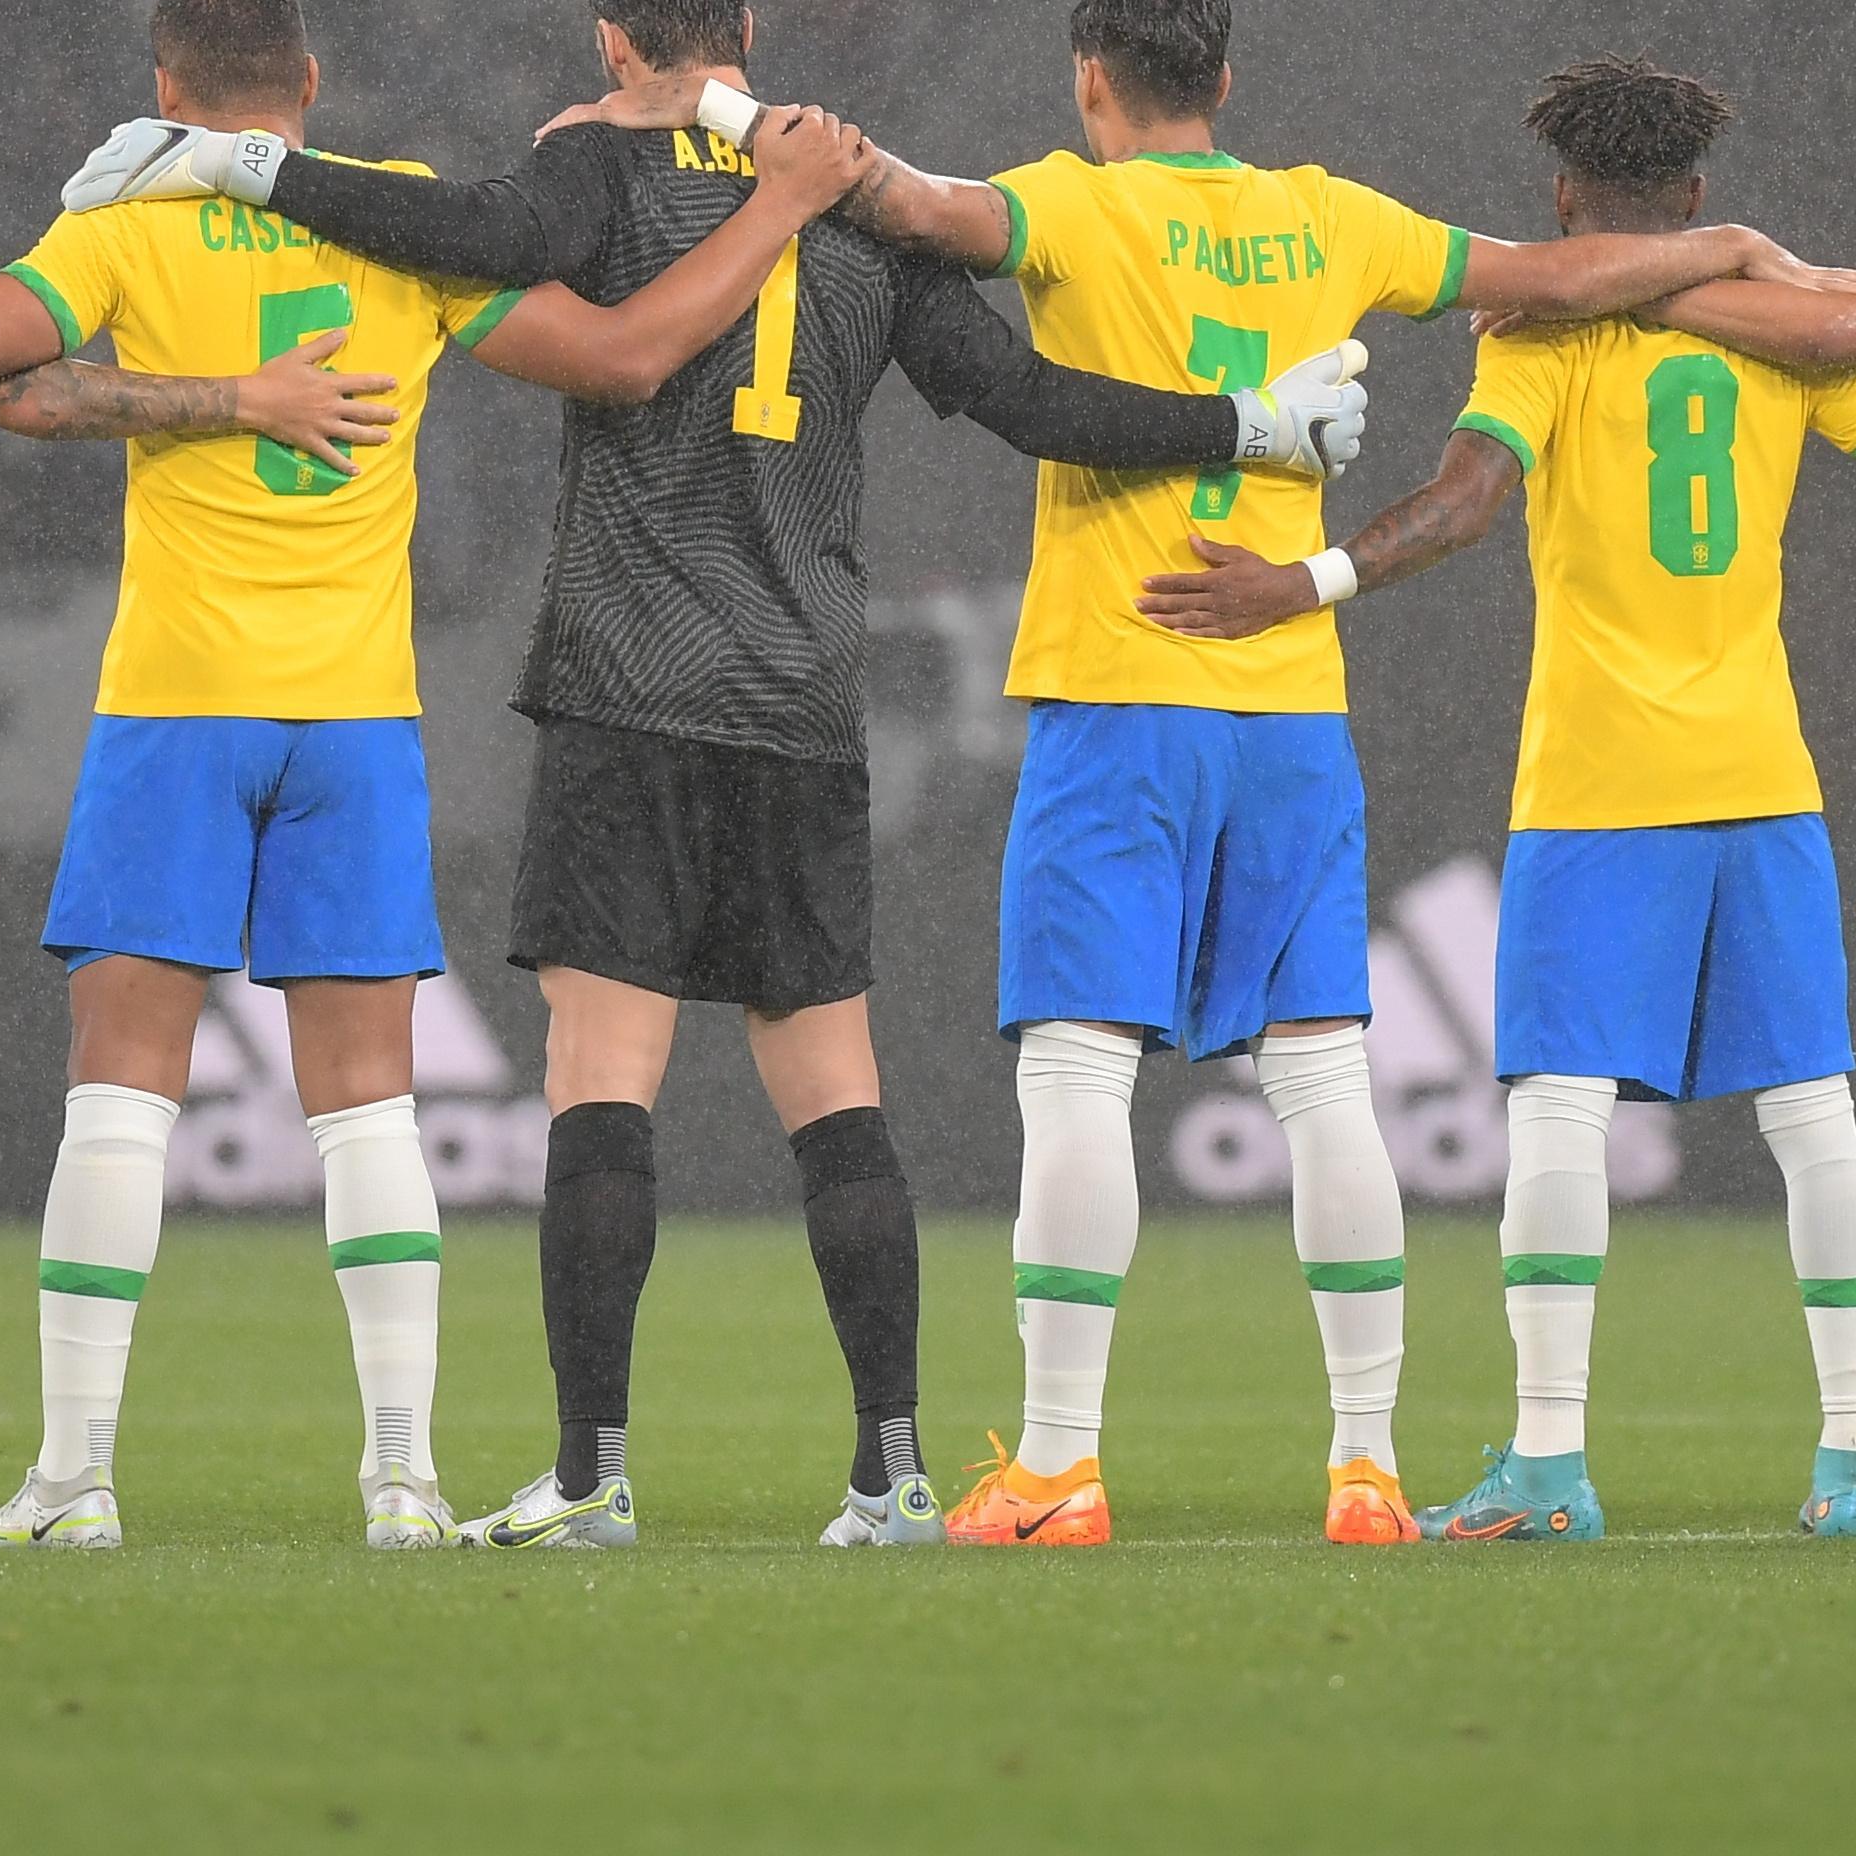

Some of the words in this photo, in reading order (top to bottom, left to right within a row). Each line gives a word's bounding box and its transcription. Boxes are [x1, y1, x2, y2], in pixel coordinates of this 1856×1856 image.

[254, 282, 353, 496] 5
[732, 233, 802, 442] 1
[1645, 354, 1739, 577] 8
